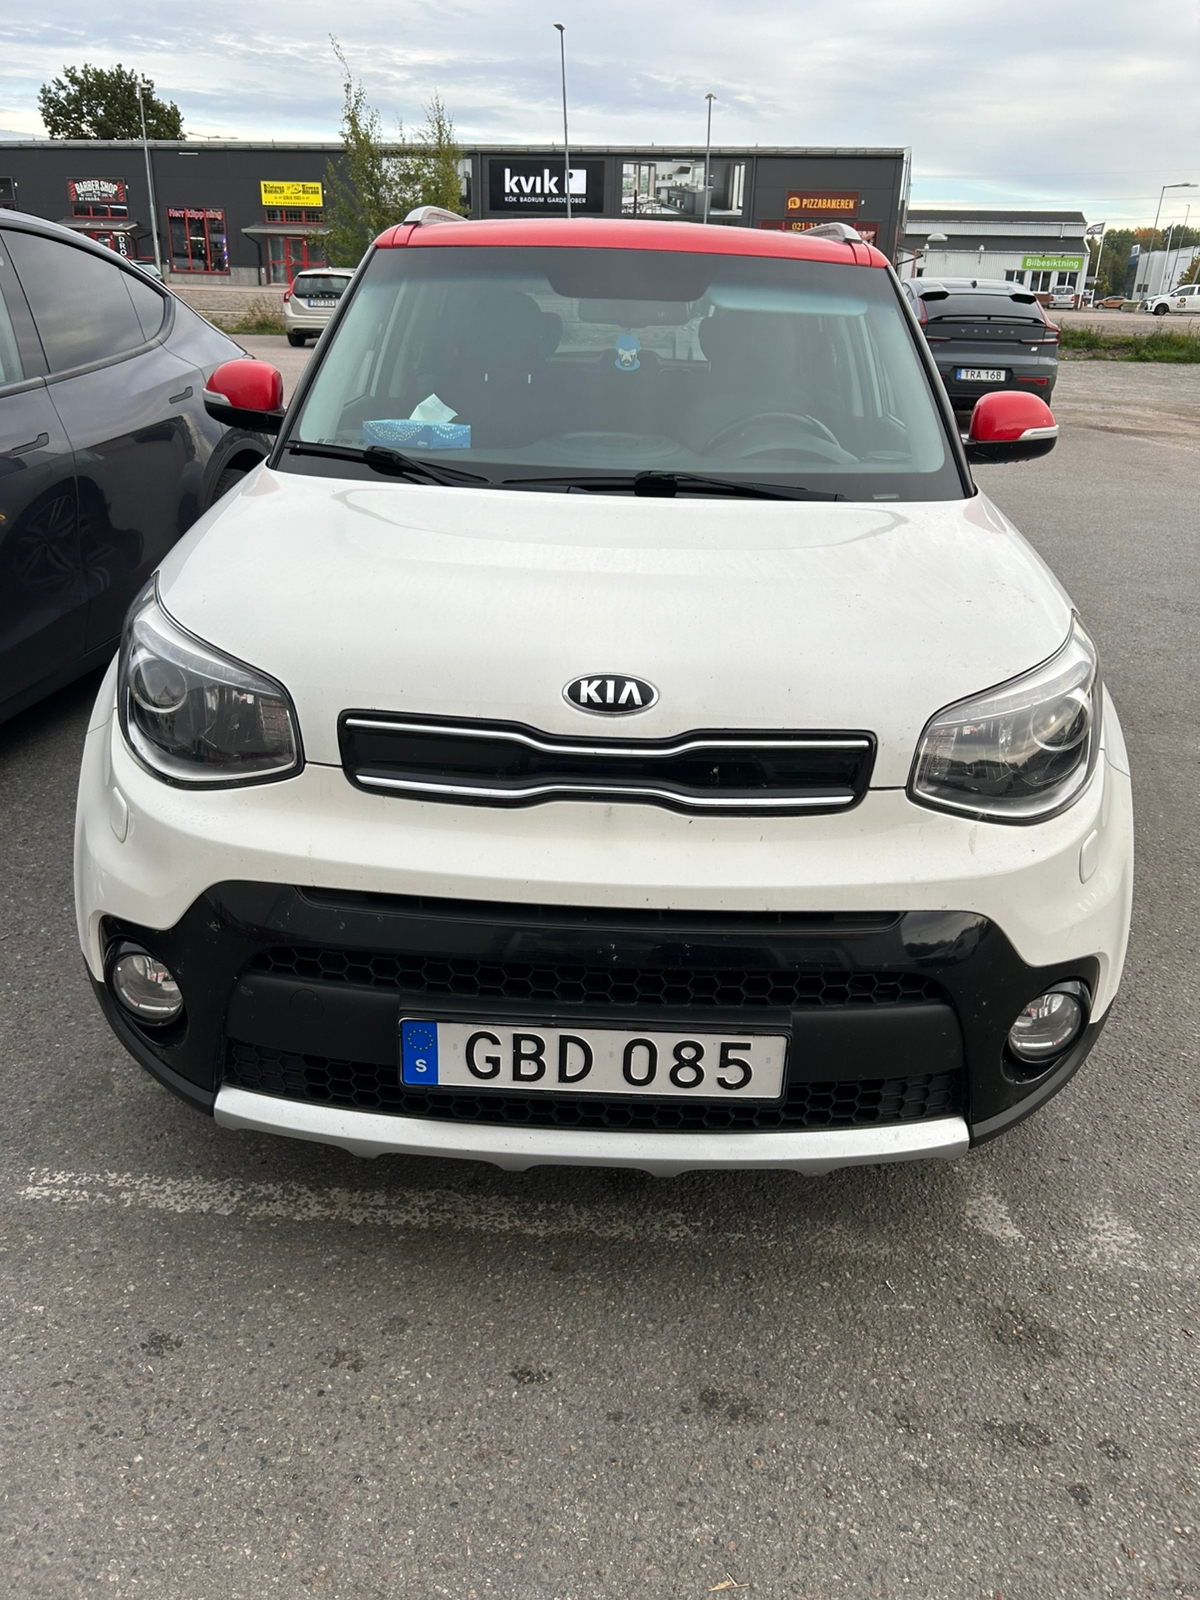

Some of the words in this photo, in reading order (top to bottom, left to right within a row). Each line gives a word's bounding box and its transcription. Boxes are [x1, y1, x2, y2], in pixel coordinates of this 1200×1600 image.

[74, 180, 100, 194] BARBER
[100, 180, 118, 194] SHOP
[504, 168, 559, 194] kvik
[504, 195, 518, 203] KÖK
[791, 222, 805, 231] 021
[1025, 258, 1080, 269] Bilbesiktning
[964, 369, 981, 379] TRA
[579, 680, 643, 706] KIA
[415, 1058, 428, 1073] S
[465, 1030, 594, 1084] GBD
[622, 1037, 753, 1091] 085
